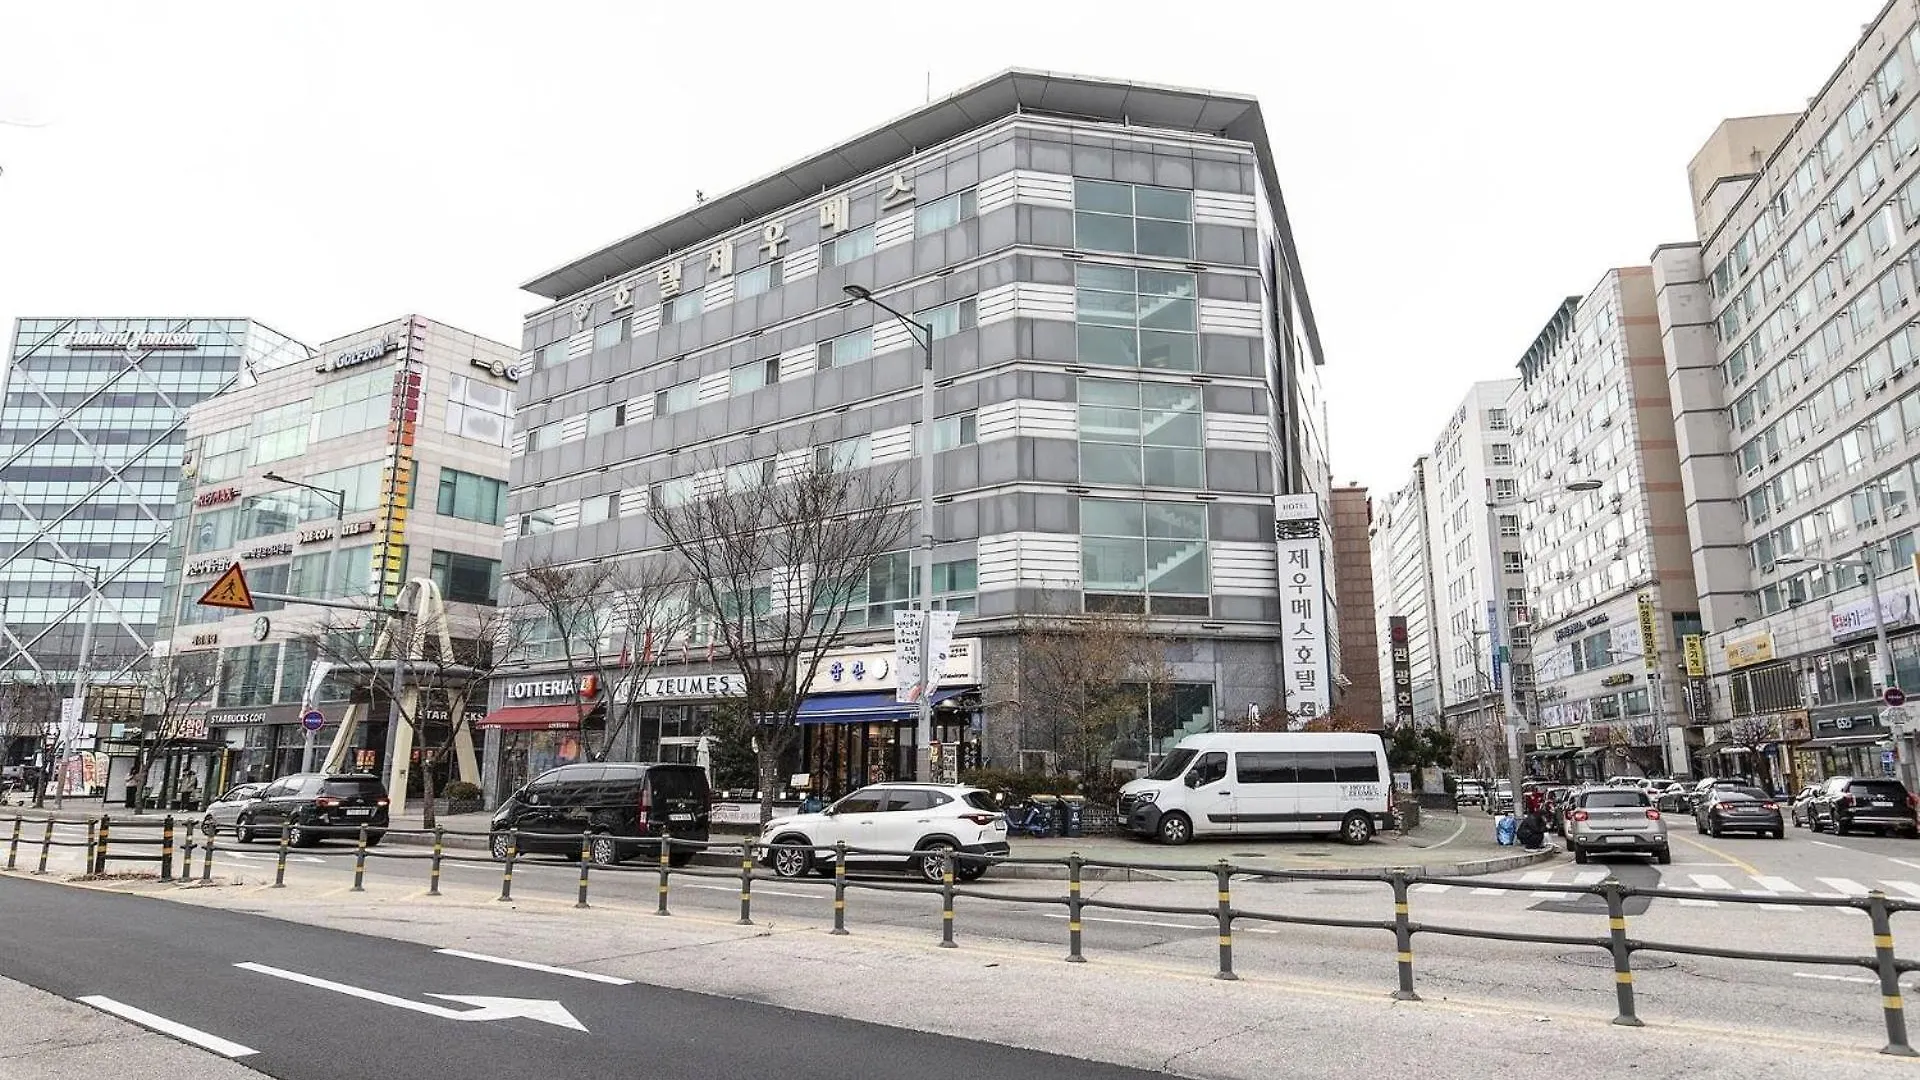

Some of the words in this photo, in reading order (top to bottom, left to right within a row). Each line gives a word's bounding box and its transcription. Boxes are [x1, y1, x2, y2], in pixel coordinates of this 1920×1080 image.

[65, 329, 127, 346] Howard
[127, 330, 198, 350] Johnson
[336, 342, 384, 369] GOLFZON
[1282, 502, 1309, 512] HOTEL
[1287, 548, 1317, 692] 제우메스호텔
[508, 679, 575, 699] LOTTERIA
[656, 676, 730, 694] ZEUMES
[211, 714, 250, 724] STARBUCKS
[418, 710, 485, 722] STARCKS
